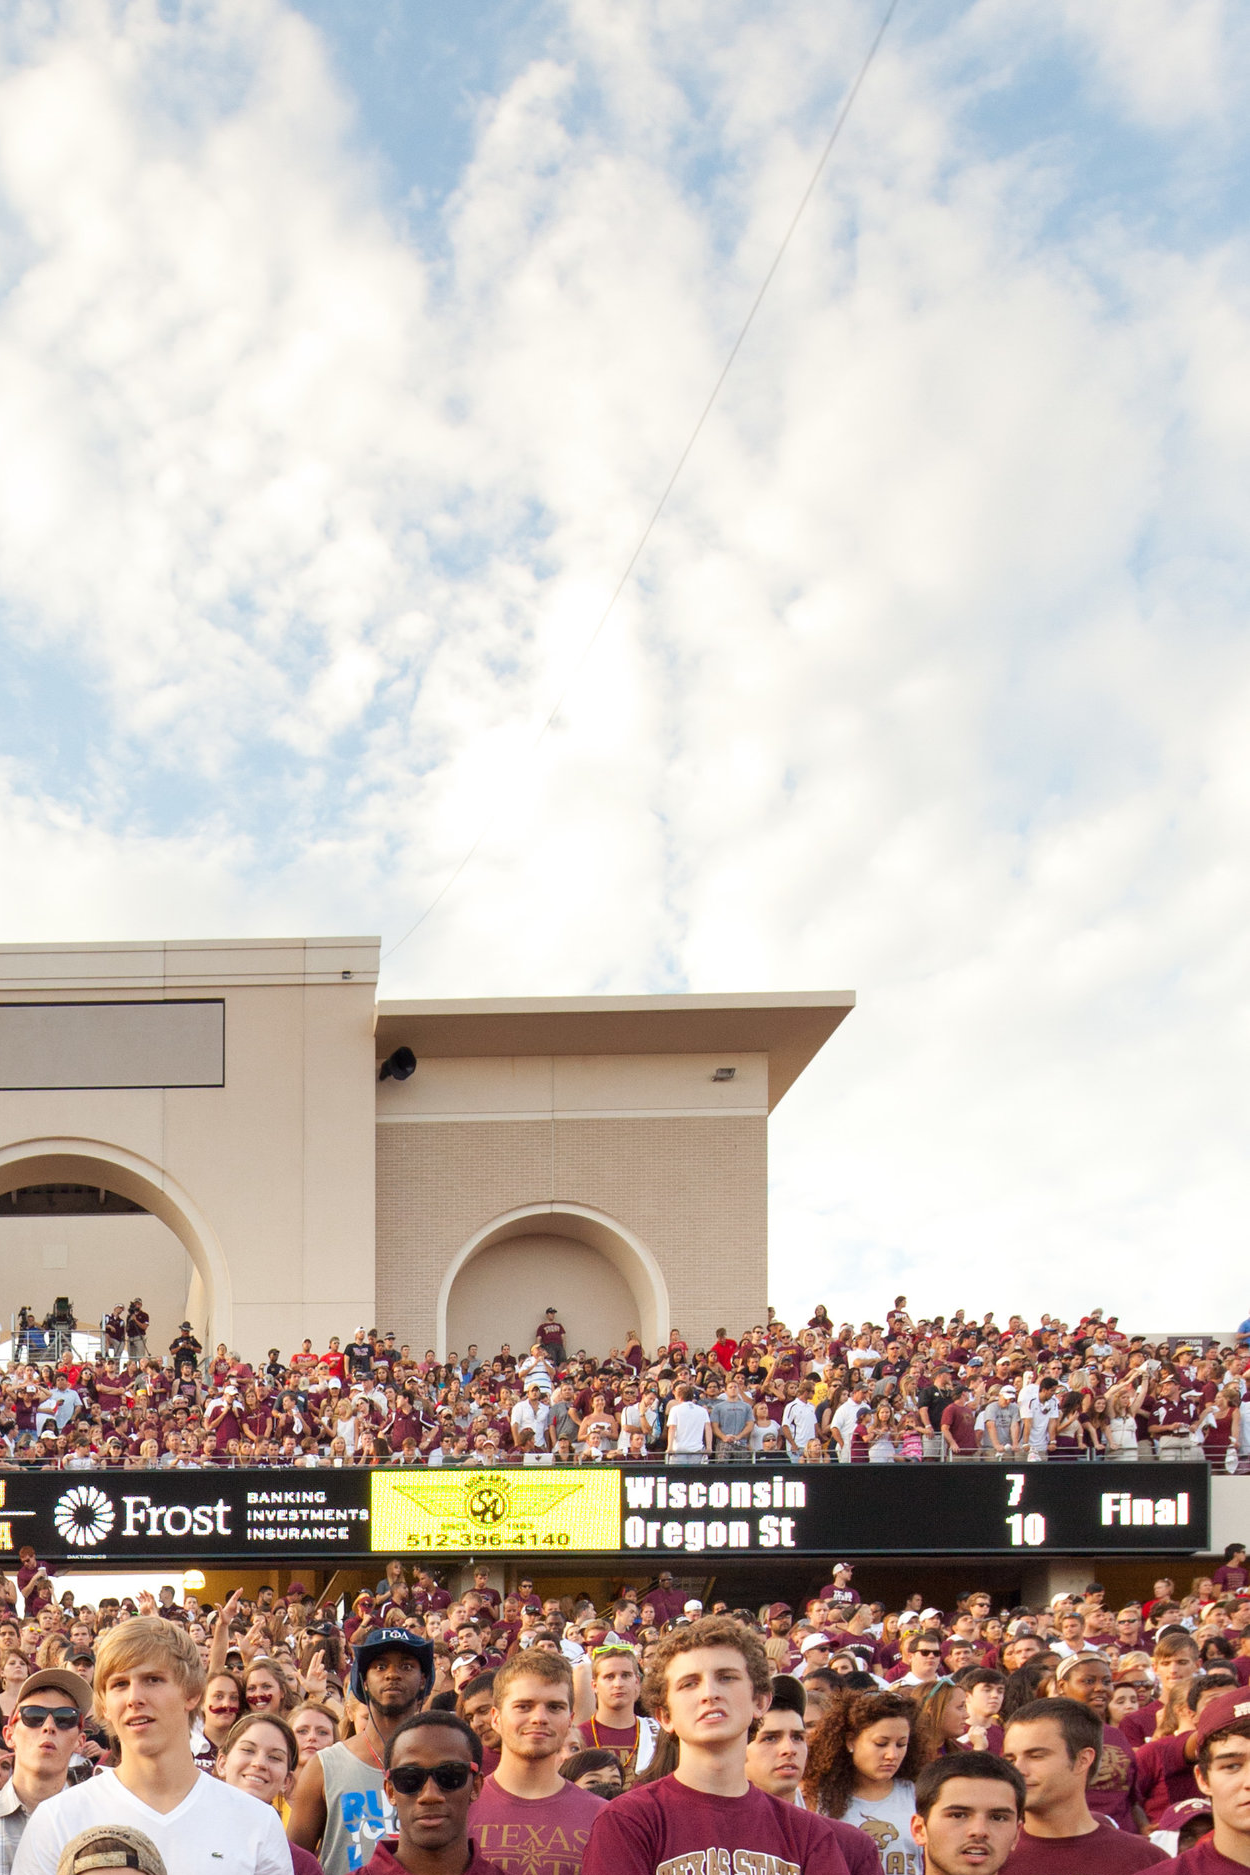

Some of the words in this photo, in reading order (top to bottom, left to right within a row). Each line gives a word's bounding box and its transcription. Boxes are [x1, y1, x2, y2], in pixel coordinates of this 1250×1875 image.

[247, 1491, 327, 1503] BANKING
[625, 1476, 806, 1509] Wisconsin
[1006, 1474, 1025, 1506] 7
[121, 1496, 231, 1537] Frost
[247, 1509, 369, 1522] INVESTMENTS
[1101, 1493, 1189, 1526] Final
[247, 1527, 349, 1541] INSURANCE
[406, 1533, 571, 1547] 512-396-4140
[625, 1516, 749, 1552] Oregon
[759, 1516, 796, 1548] St
[1006, 1513, 1046, 1546] 10
[474, 1824, 591, 1855] TEXAS
